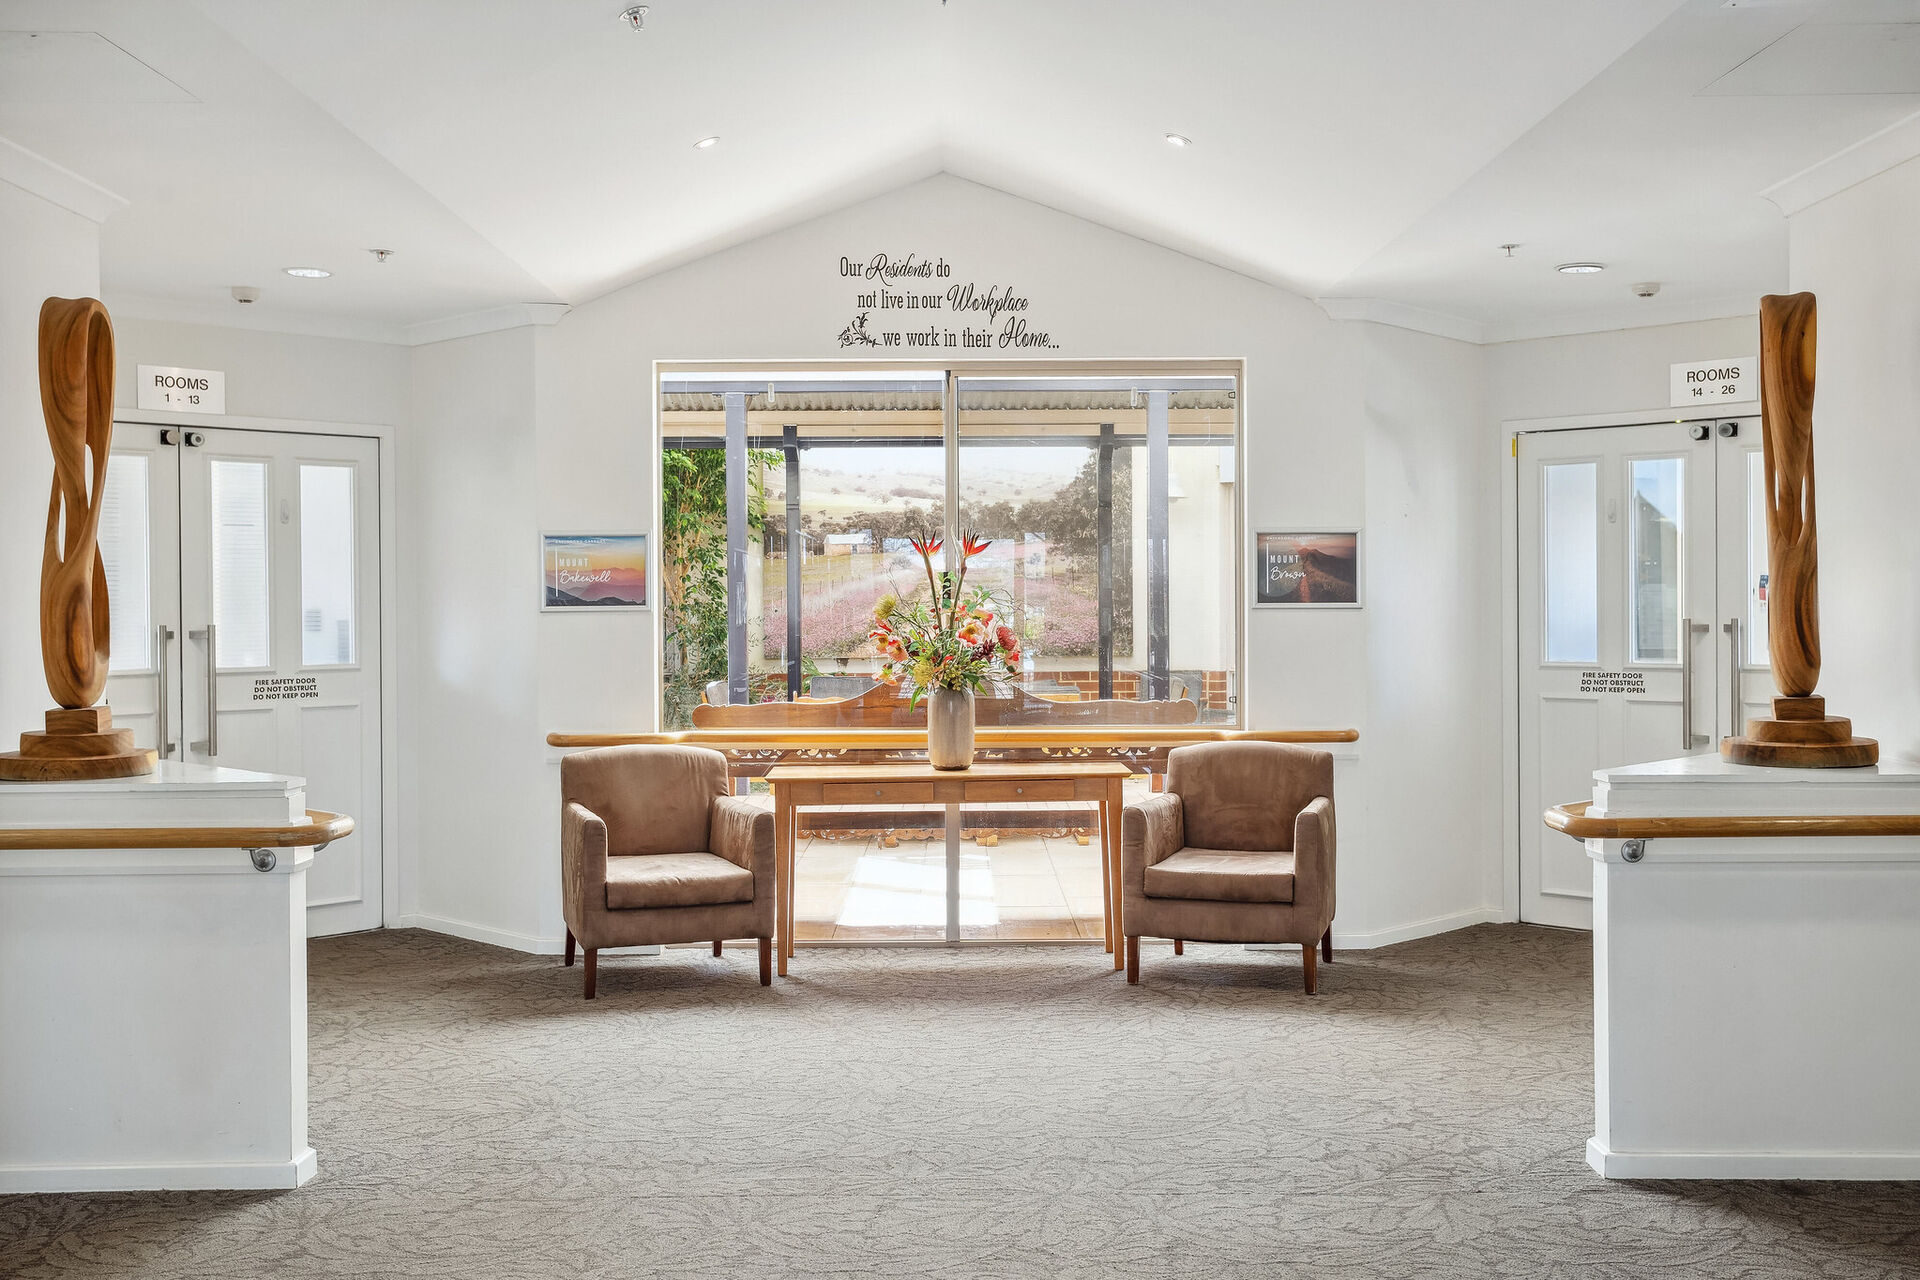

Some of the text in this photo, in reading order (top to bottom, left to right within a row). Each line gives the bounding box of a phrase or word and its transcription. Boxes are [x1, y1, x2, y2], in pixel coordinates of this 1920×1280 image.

[840, 253, 950, 286] Our Residents do
[857, 283, 1029, 325] not live in our Workplace
[882, 331, 901, 347] we
[907, 326, 939, 347] work
[944, 328, 957, 347] in
[962, 327, 993, 348] their
[155, 375, 209, 390] ROOMS
[1686, 367, 1740, 383] ROOMS
[1691, 387, 1703, 397] 14
[1721, 384, 1736, 395] 26
[164, 393, 170, 402] 1
[188, 395, 200, 405] 13
[559, 558, 588, 567] MOUNT
[1270, 554, 1299, 564] MOUNT
[559, 569, 611, 584] Bakewell
